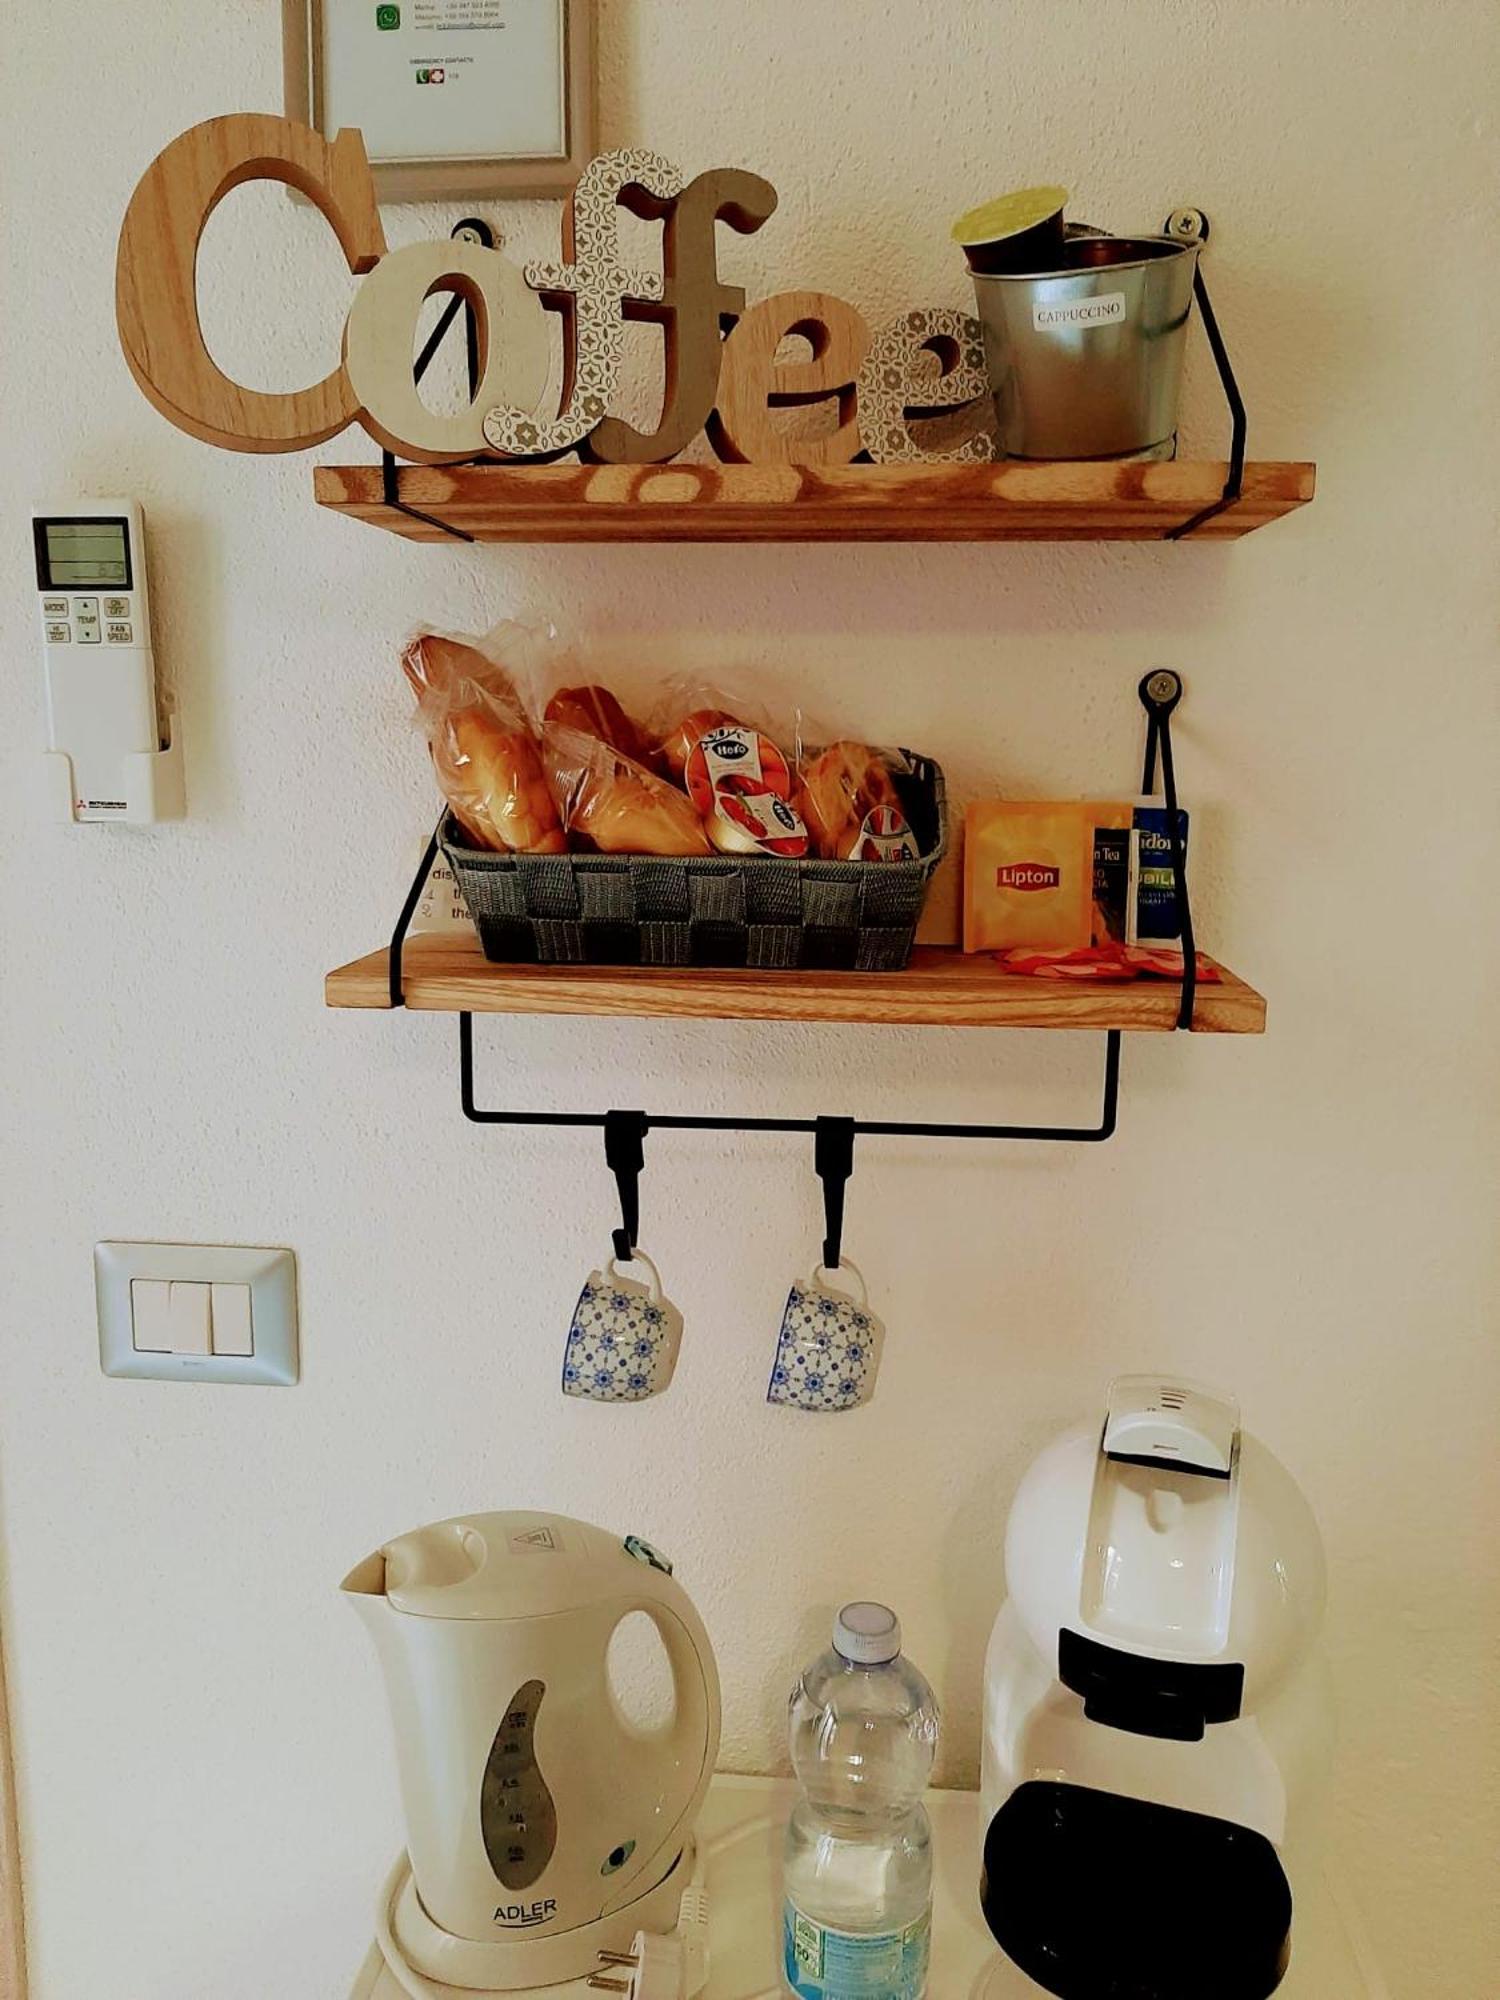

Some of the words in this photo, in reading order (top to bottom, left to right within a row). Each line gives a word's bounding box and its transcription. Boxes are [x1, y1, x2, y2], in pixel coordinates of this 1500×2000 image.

[116, 112, 999, 466] Coffee
[1037, 302, 1120, 323] CAPPUCCINO
[77, 615, 96, 624] TEMP
[110, 625, 125, 633] FAN
[1102, 847, 1120, 861] Tea
[1001, 868, 1055, 887] Lipton
[493, 1898, 557, 1921] ADLER
